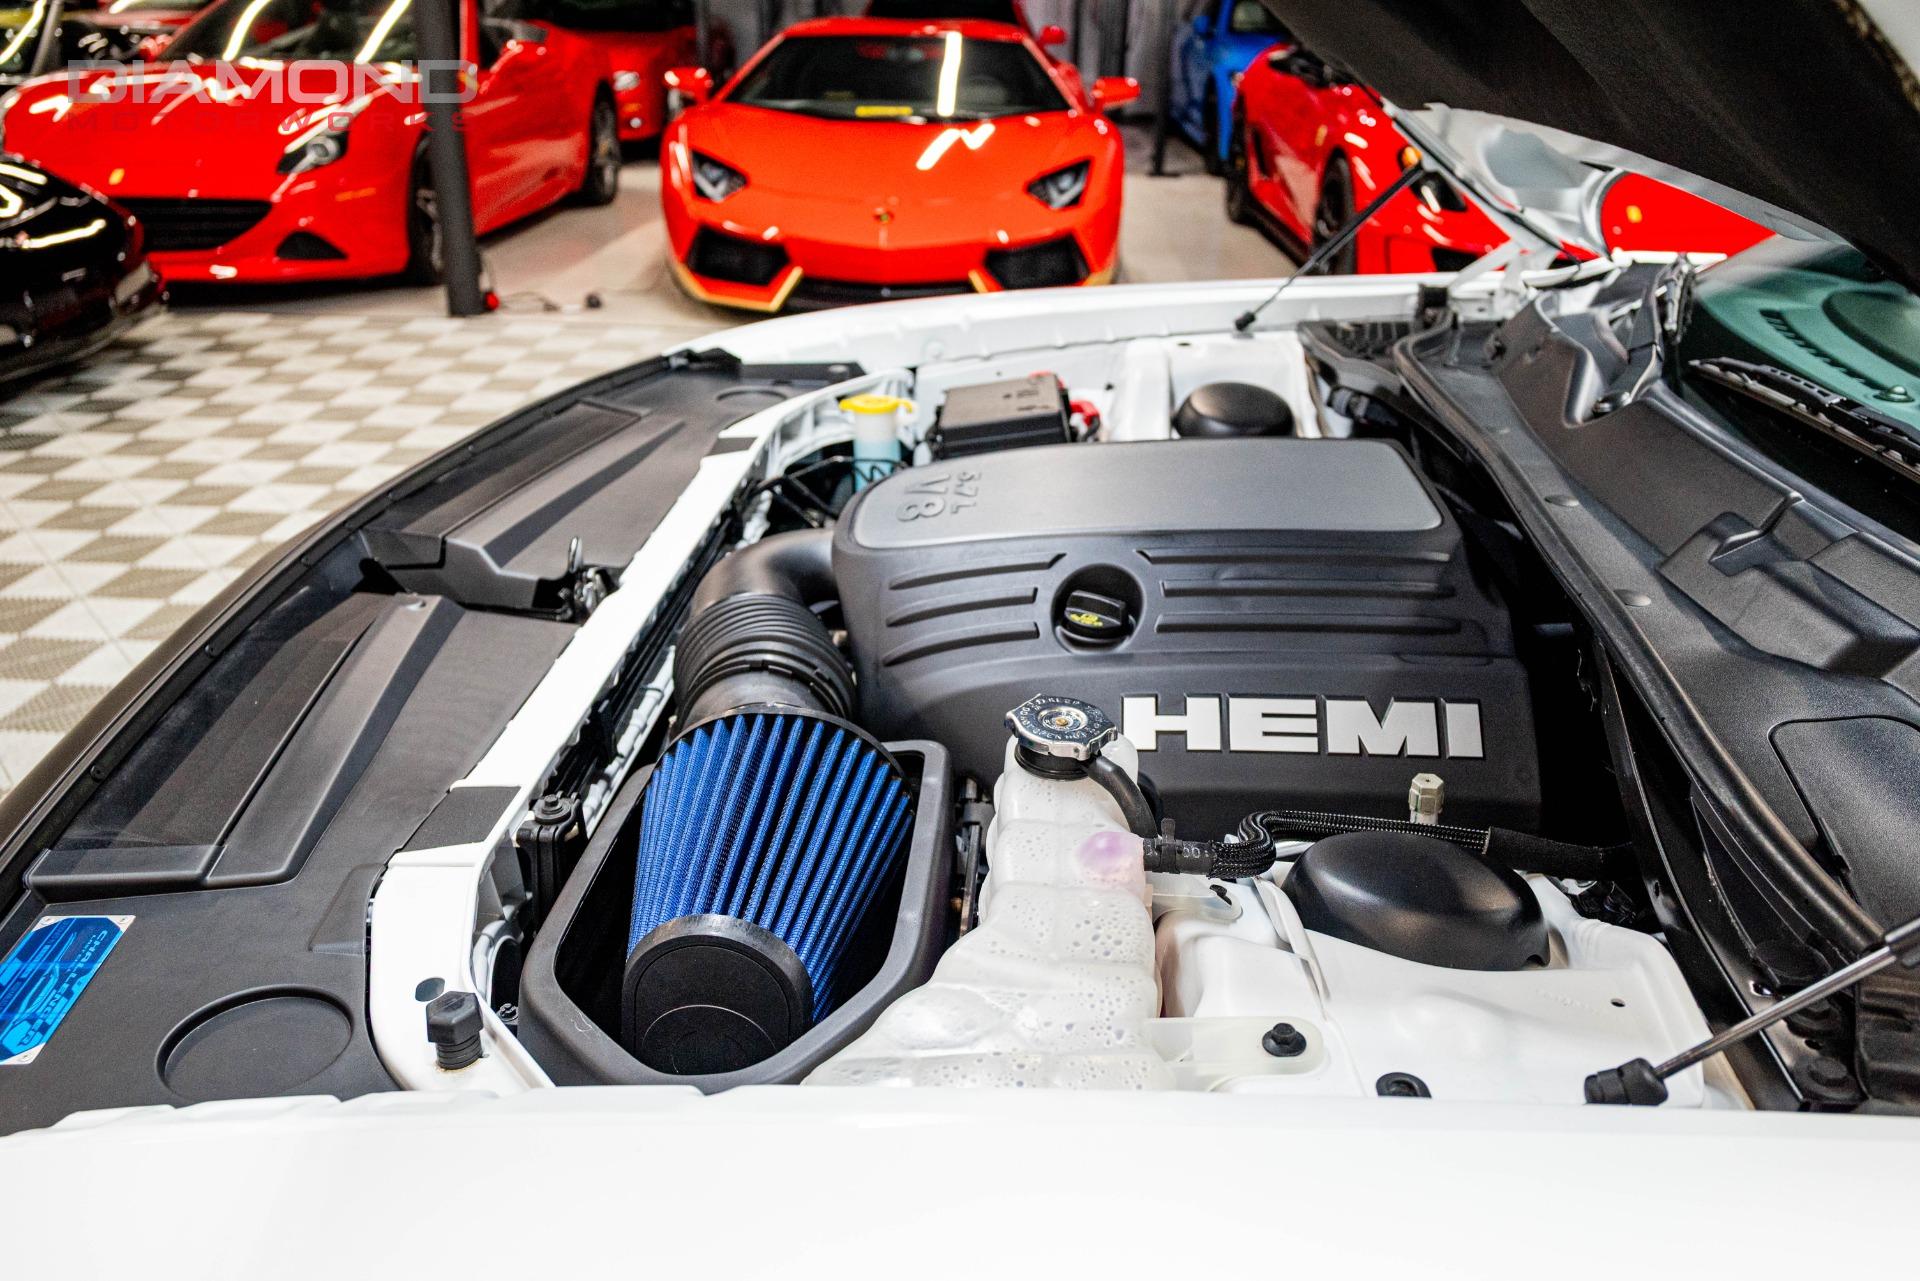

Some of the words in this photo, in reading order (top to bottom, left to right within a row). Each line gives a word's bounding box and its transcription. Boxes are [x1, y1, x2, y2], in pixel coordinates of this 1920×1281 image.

[896, 472, 952, 523] V8
[1122, 693, 1485, 759] HEMI
[17, 929, 108, 1046] CHALLENGER
